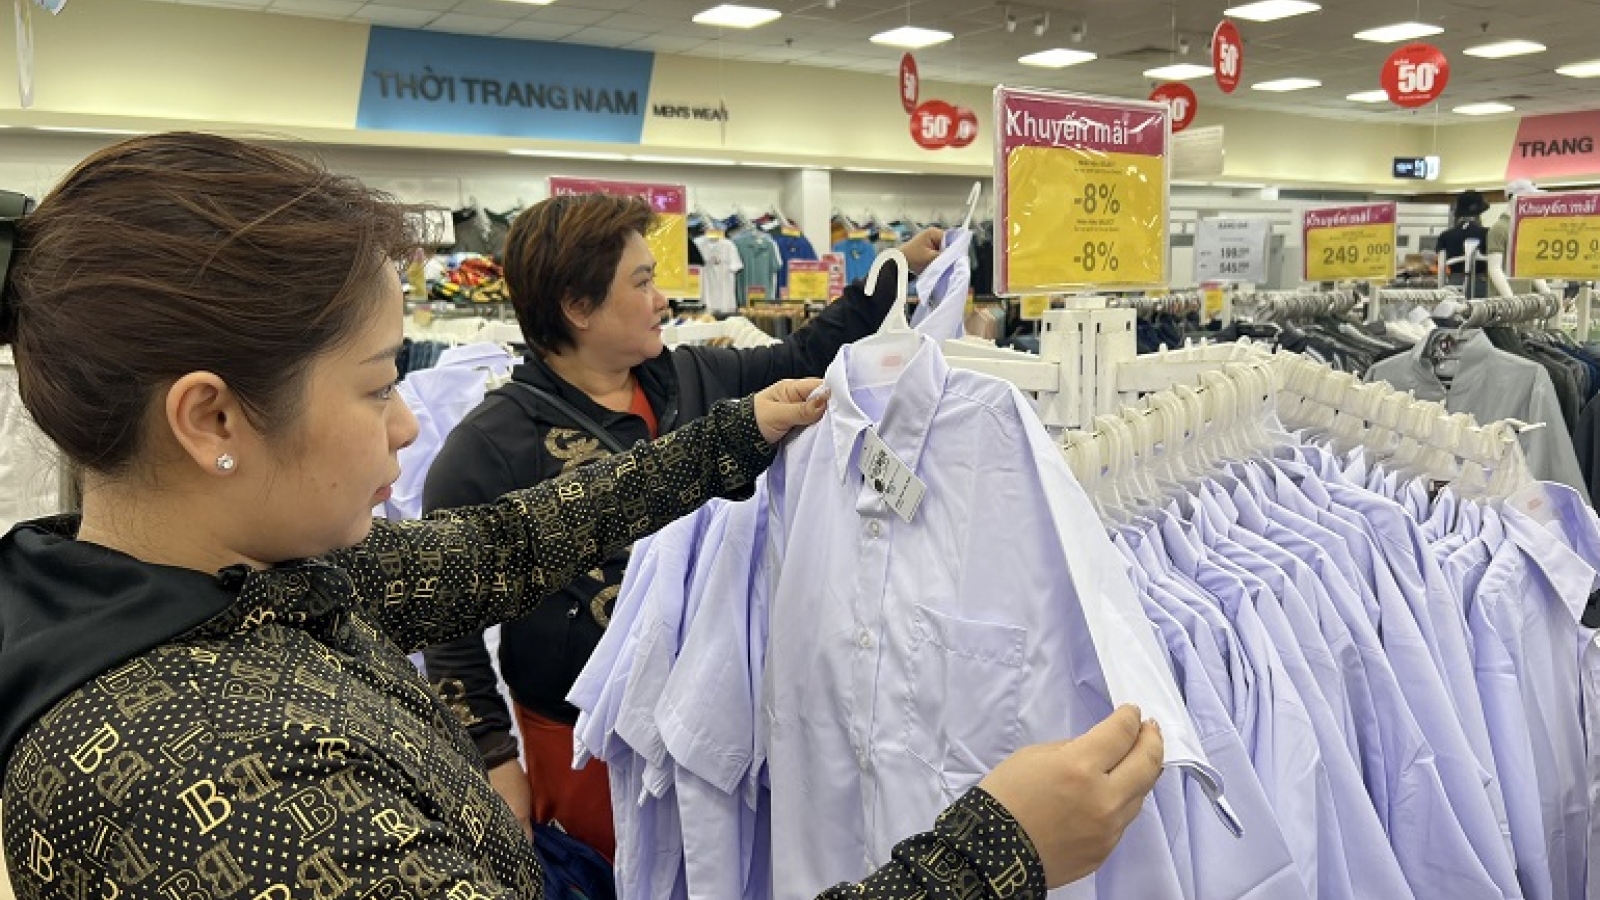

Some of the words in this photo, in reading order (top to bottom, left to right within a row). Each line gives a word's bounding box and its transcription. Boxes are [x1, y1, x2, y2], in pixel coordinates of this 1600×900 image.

[373, 66, 456, 103] THỜI
[461, 76, 568, 111] TRANG
[573, 87, 639, 115] NAM
[1519, 136, 1594, 159] TRANG
[1074, 183, 1120, 215] -8%
[1074, 241, 1119, 272] -8%
[1323, 246, 1359, 265] 249
[1536, 239, 1579, 260] 299
